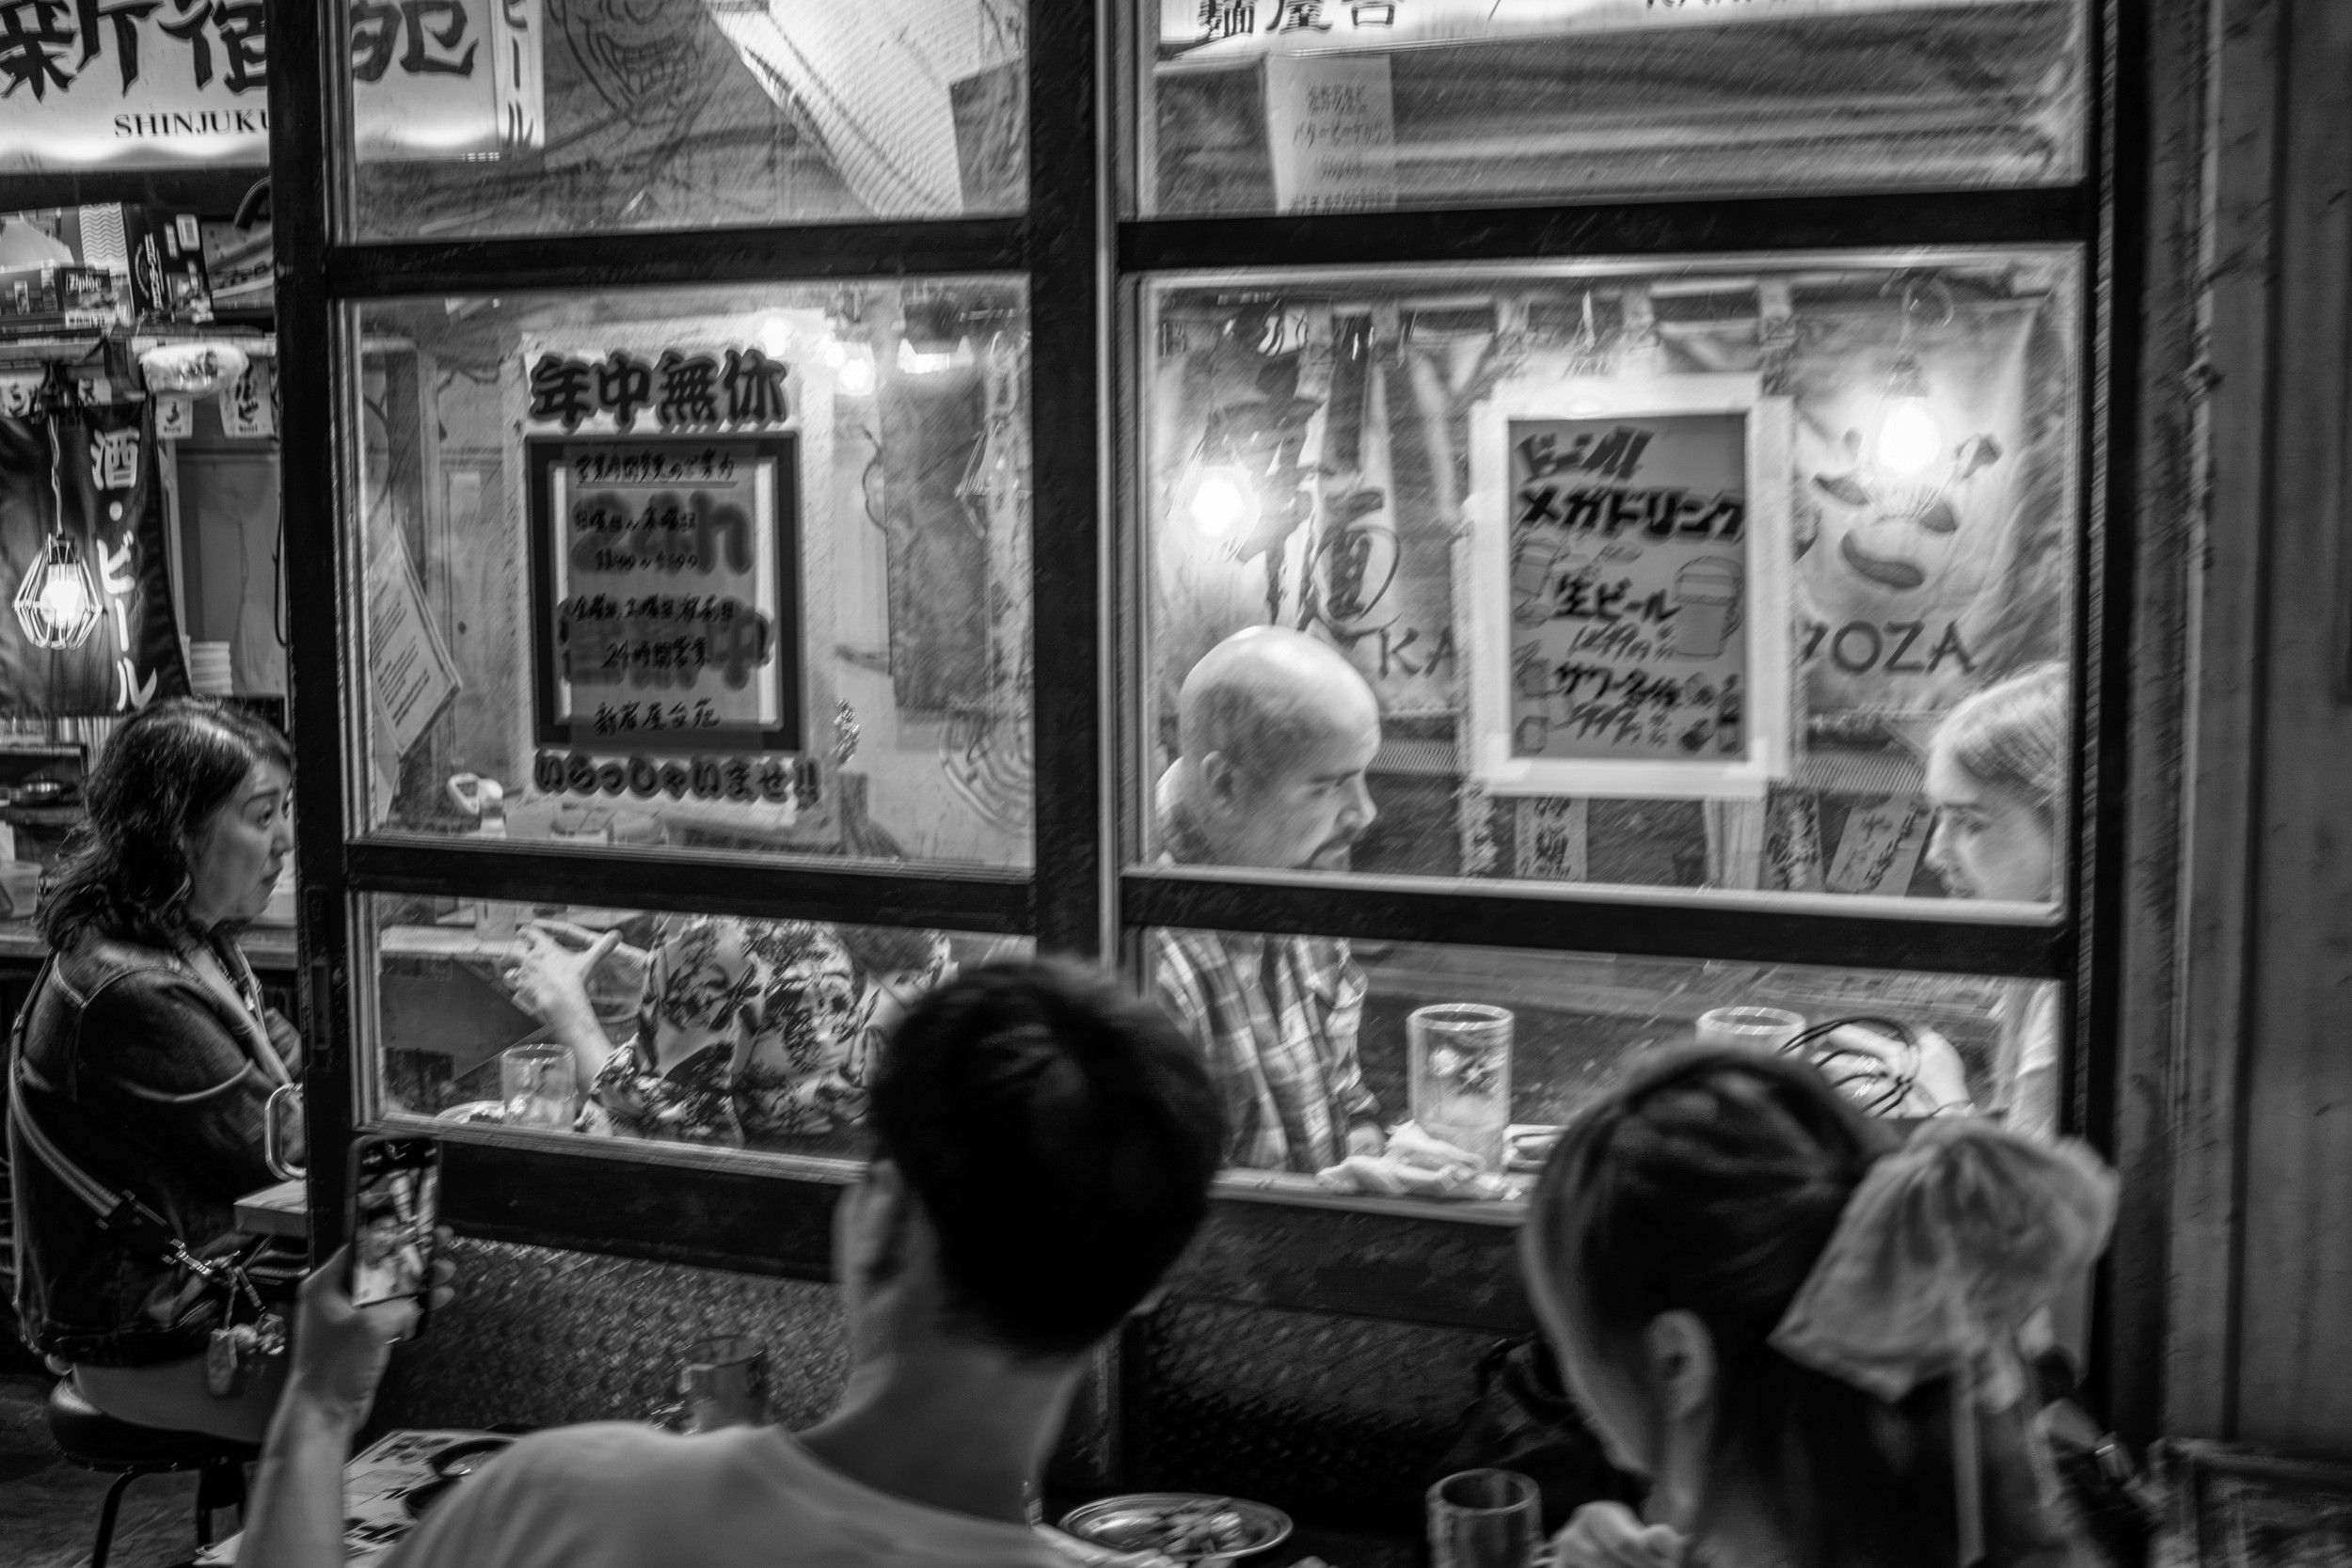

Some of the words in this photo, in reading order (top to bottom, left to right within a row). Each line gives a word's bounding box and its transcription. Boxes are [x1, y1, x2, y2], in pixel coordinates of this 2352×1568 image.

[531, 350, 788, 425] 年中無休
[1517, 485, 1743, 538] メガドリンク
